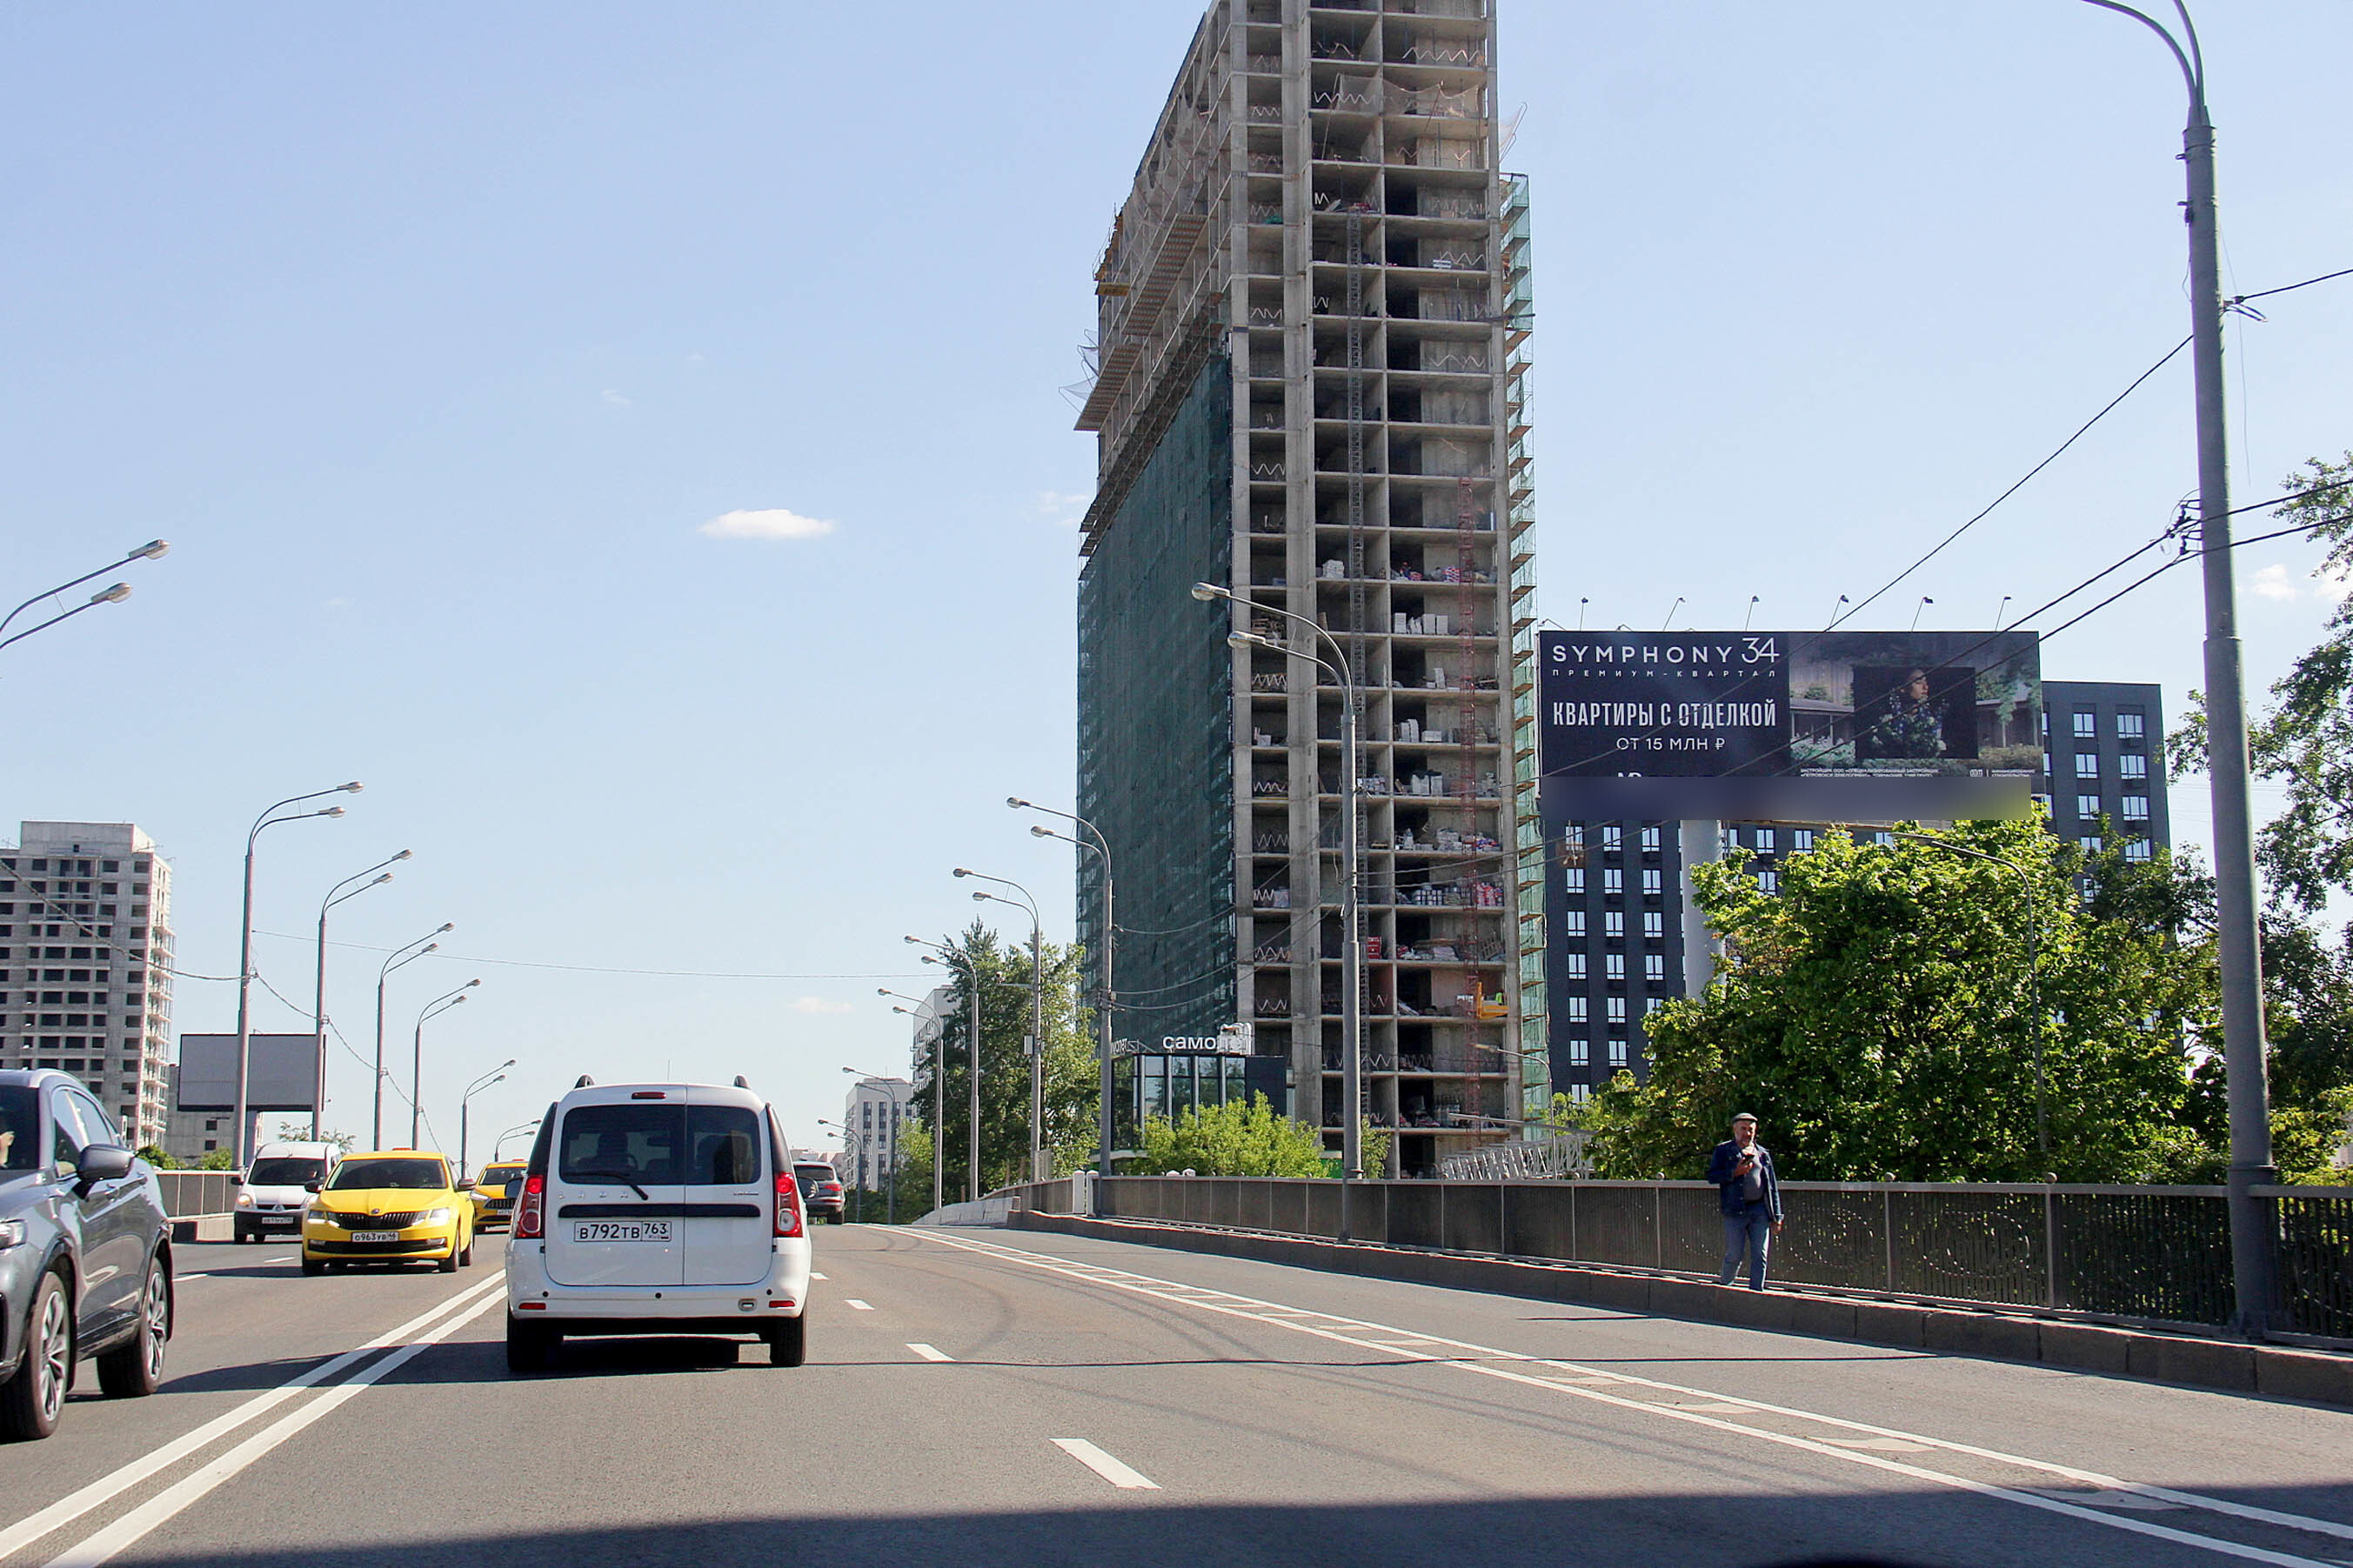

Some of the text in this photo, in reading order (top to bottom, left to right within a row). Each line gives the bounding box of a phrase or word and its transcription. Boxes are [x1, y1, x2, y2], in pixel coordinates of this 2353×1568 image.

[1552, 637, 1780, 664] SYMPHONY 34
[1553, 698, 1777, 730] КВАРТИРЫ С ОТДЕЛКОЙ
[1615, 737, 1641, 751] ОТ
[1645, 737, 1663, 751] 15
[1668, 737, 1709, 751] МЛН
[1162, 1036, 1217, 1051] само
